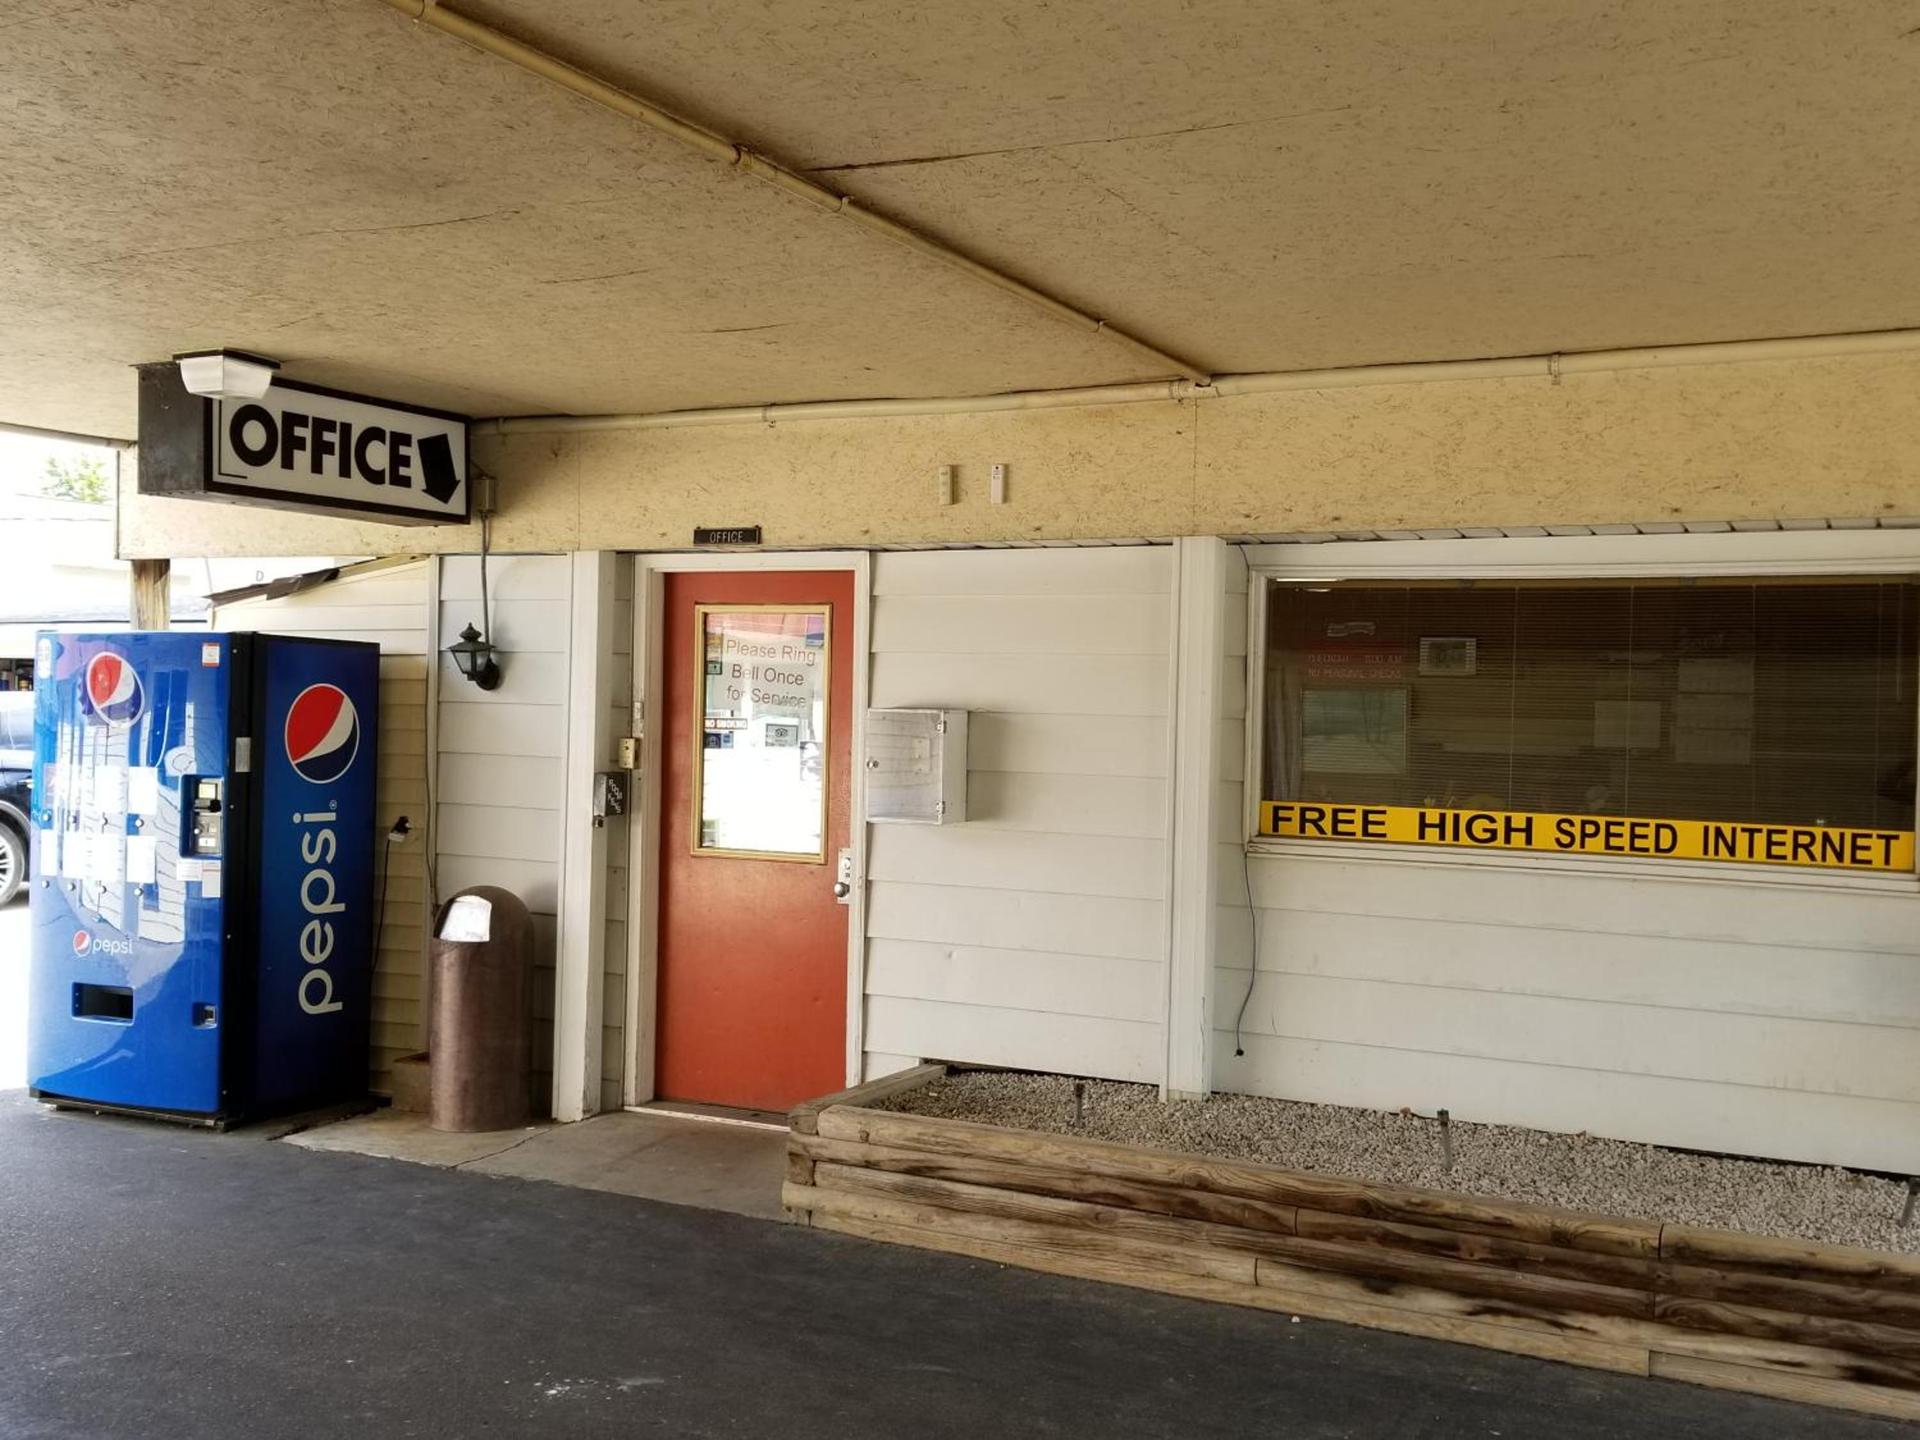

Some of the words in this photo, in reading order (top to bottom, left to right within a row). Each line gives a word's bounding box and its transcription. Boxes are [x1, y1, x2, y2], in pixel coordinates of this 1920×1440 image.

[229, 404, 413, 489] OFFICE
[709, 530, 743, 544] OFFICE
[726, 639, 777, 659] Please
[782, 644, 816, 667] Ring
[731, 663, 760, 681] Bell
[764, 667, 805, 686] Once
[726, 685, 746, 701] for
[751, 687, 807, 709] Service
[1271, 806, 1388, 839] FREE
[1418, 810, 1534, 847] HIGH
[1554, 818, 1678, 855] SPEED
[1702, 825, 1901, 866] INTERNET
[292, 811, 346, 1015] pepsi
[92, 937, 134, 956] pepsi
